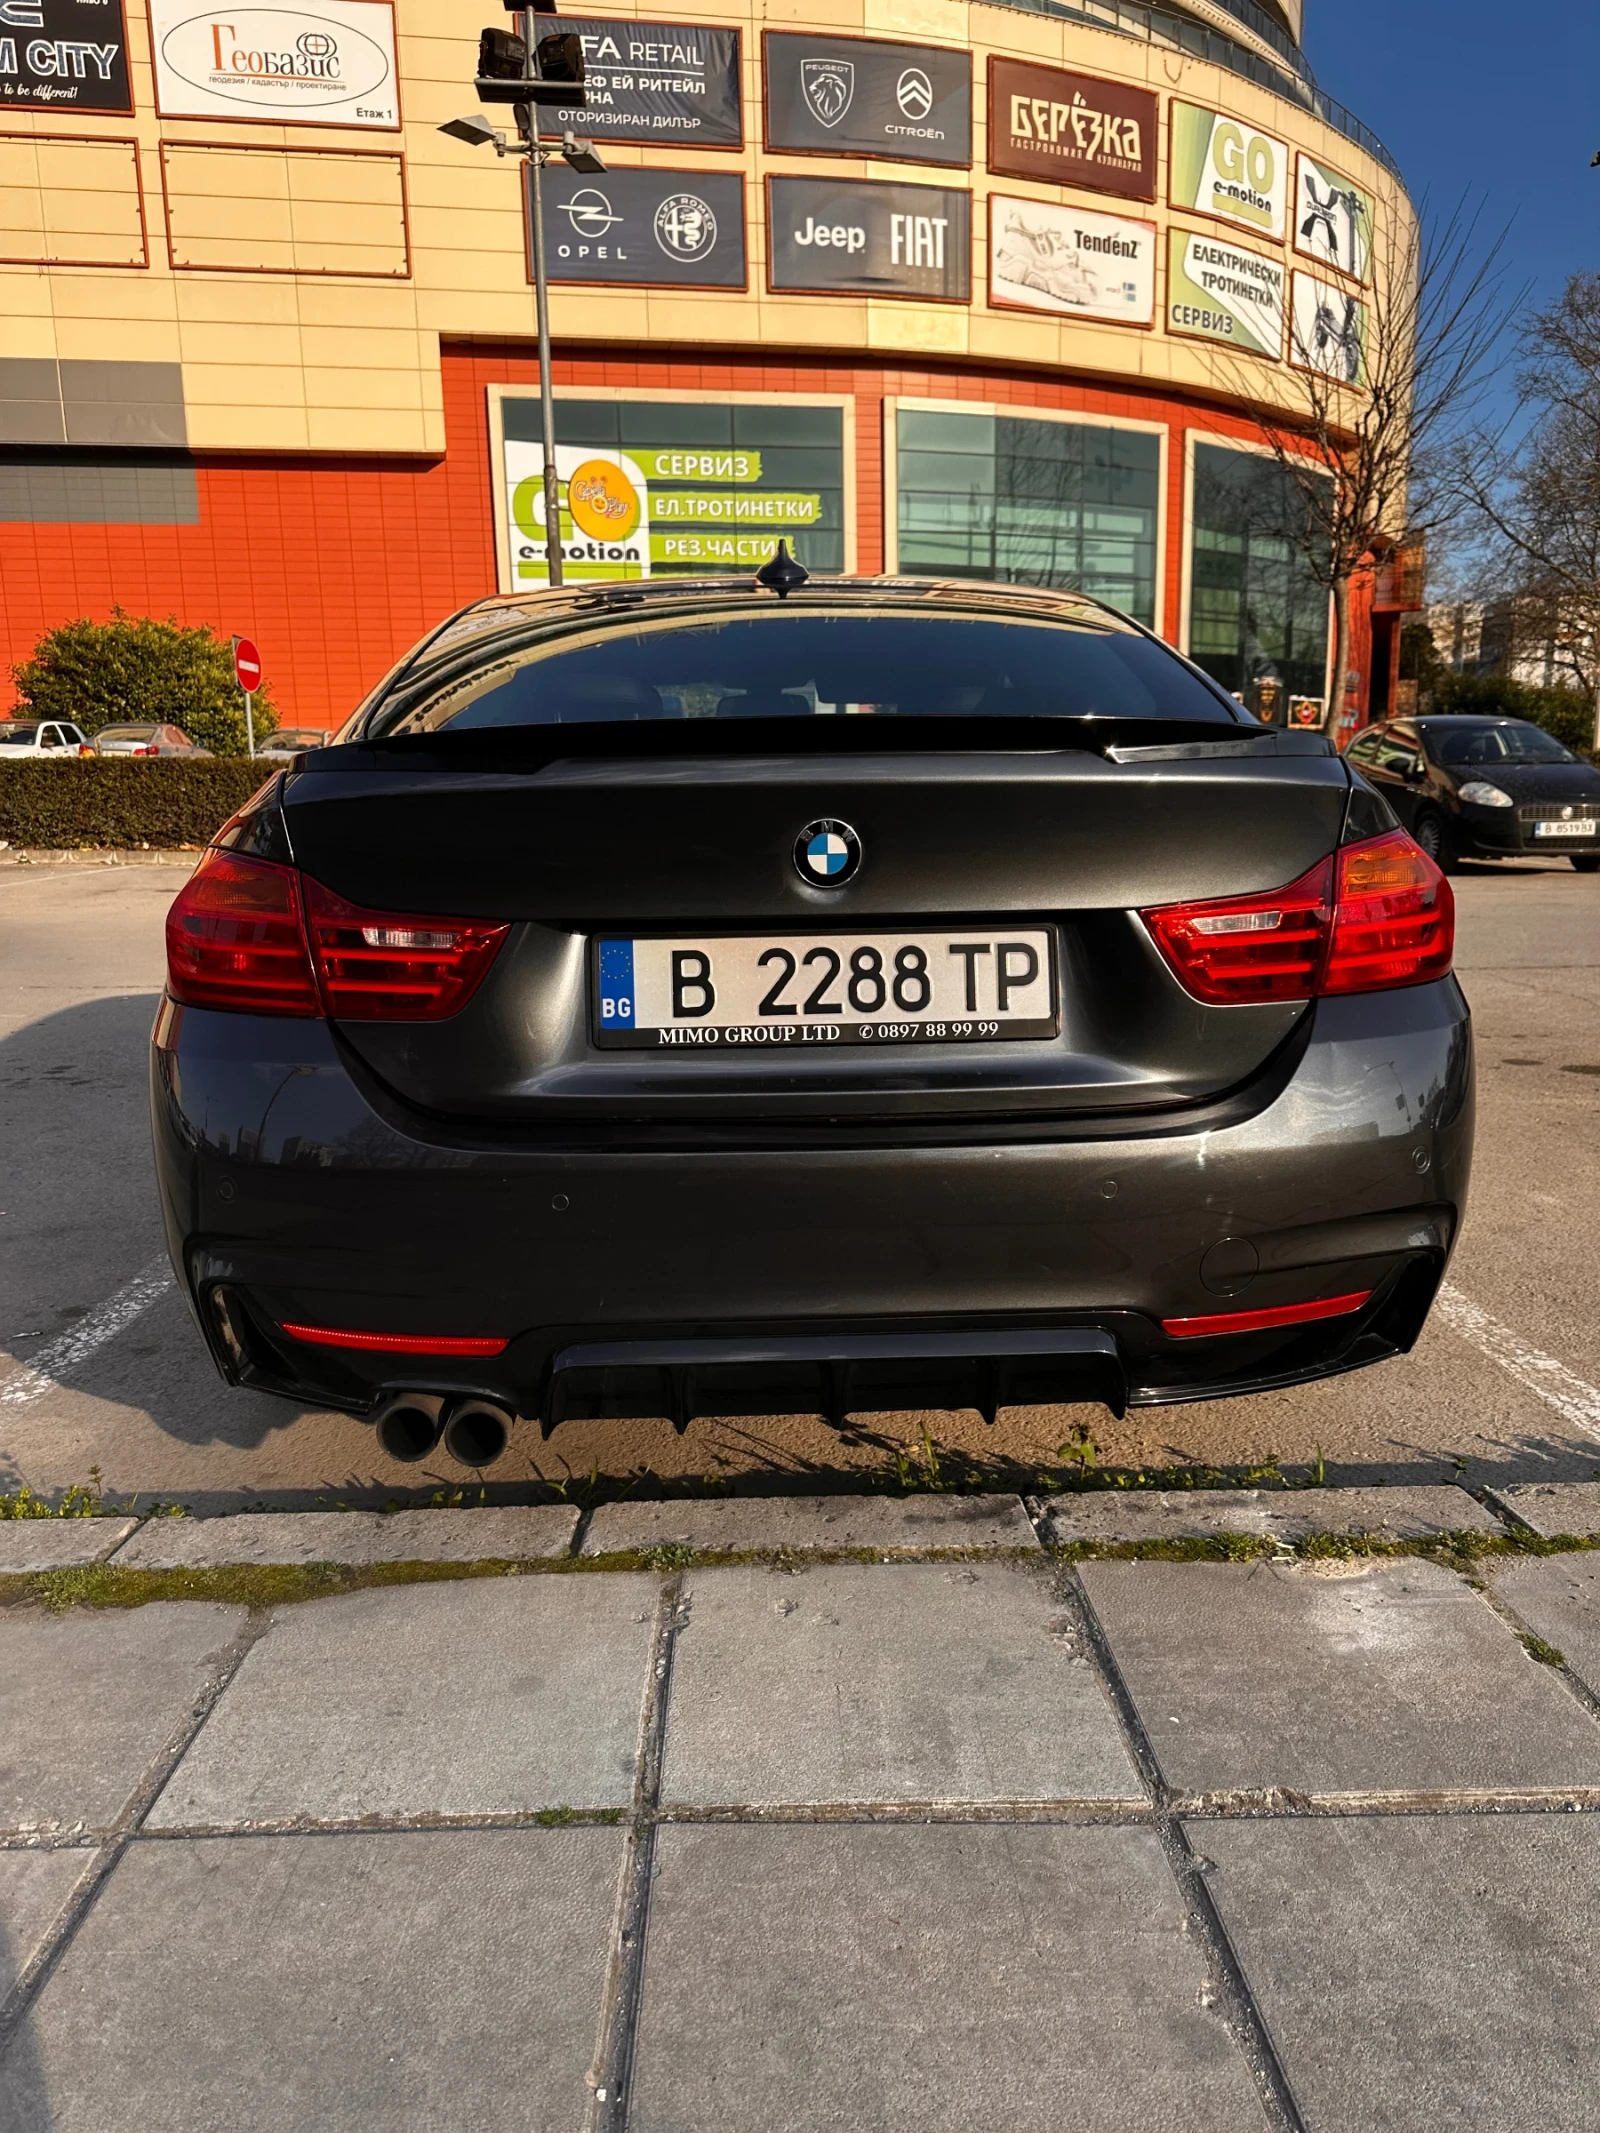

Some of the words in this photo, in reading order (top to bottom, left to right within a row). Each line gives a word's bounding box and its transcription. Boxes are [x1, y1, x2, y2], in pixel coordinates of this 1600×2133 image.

[26, 39, 119, 79] CITY
[630, 42, 704, 65] RETAIL
[805, 64, 849, 73] PEUGEOT
[17, 83, 30, 95] be
[33, 84, 78, 100] different!
[209, 76, 245, 85] геодезия
[252, 79, 289, 88] кадастър
[296, 81, 347, 91] проектиране
[612, 75, 633, 89] ЕЙ
[639, 78, 705, 95] РИТЕЙЛ
[356, 108, 384, 119] Етаж
[387, 110, 392, 119] 1
[558, 110, 649, 126] ОТОРИЗИРАН
[652, 116, 701, 128] ДИЛЪР
[1213, 122, 1275, 195] GO
[1213, 181, 1272, 213] e-motion
[657, 200, 677, 227] ALFA
[681, 198, 714, 231] ROMEO
[794, 217, 866, 253] Jeep
[891, 214, 948, 268] FIAT
[558, 245, 627, 260] OPEL
[1193, 244, 1281, 288] ЕЛЕКТРИЧЕСКИ
[1201, 271, 1273, 308] ТРОТИНЕТКИ
[1172, 304, 1233, 335] СЕРВИЗ
[655, 454, 749, 478] СЕРВИЗ
[655, 498, 813, 518] ЕЛ.ТРОТИНЕТКИ
[665, 539, 777, 557] РЕЗ.ЧАСТИ
[799, 821, 856, 843] BMW
[671, 950, 715, 1018] B
[757, 946, 932, 1016] 2288
[949, 943, 1040, 1012] TP
[602, 998, 631, 1018] BG
[658, 1027, 719, 1044] MIMO
[724, 1025, 796, 1043] GROUP
[801, 1025, 840, 1041] LTD
[878, 1024, 919, 1038] 0897
[925, 1023, 946, 1037] 88
[951, 1022, 972, 1036] 99
[978, 1021, 999, 1036] 99
